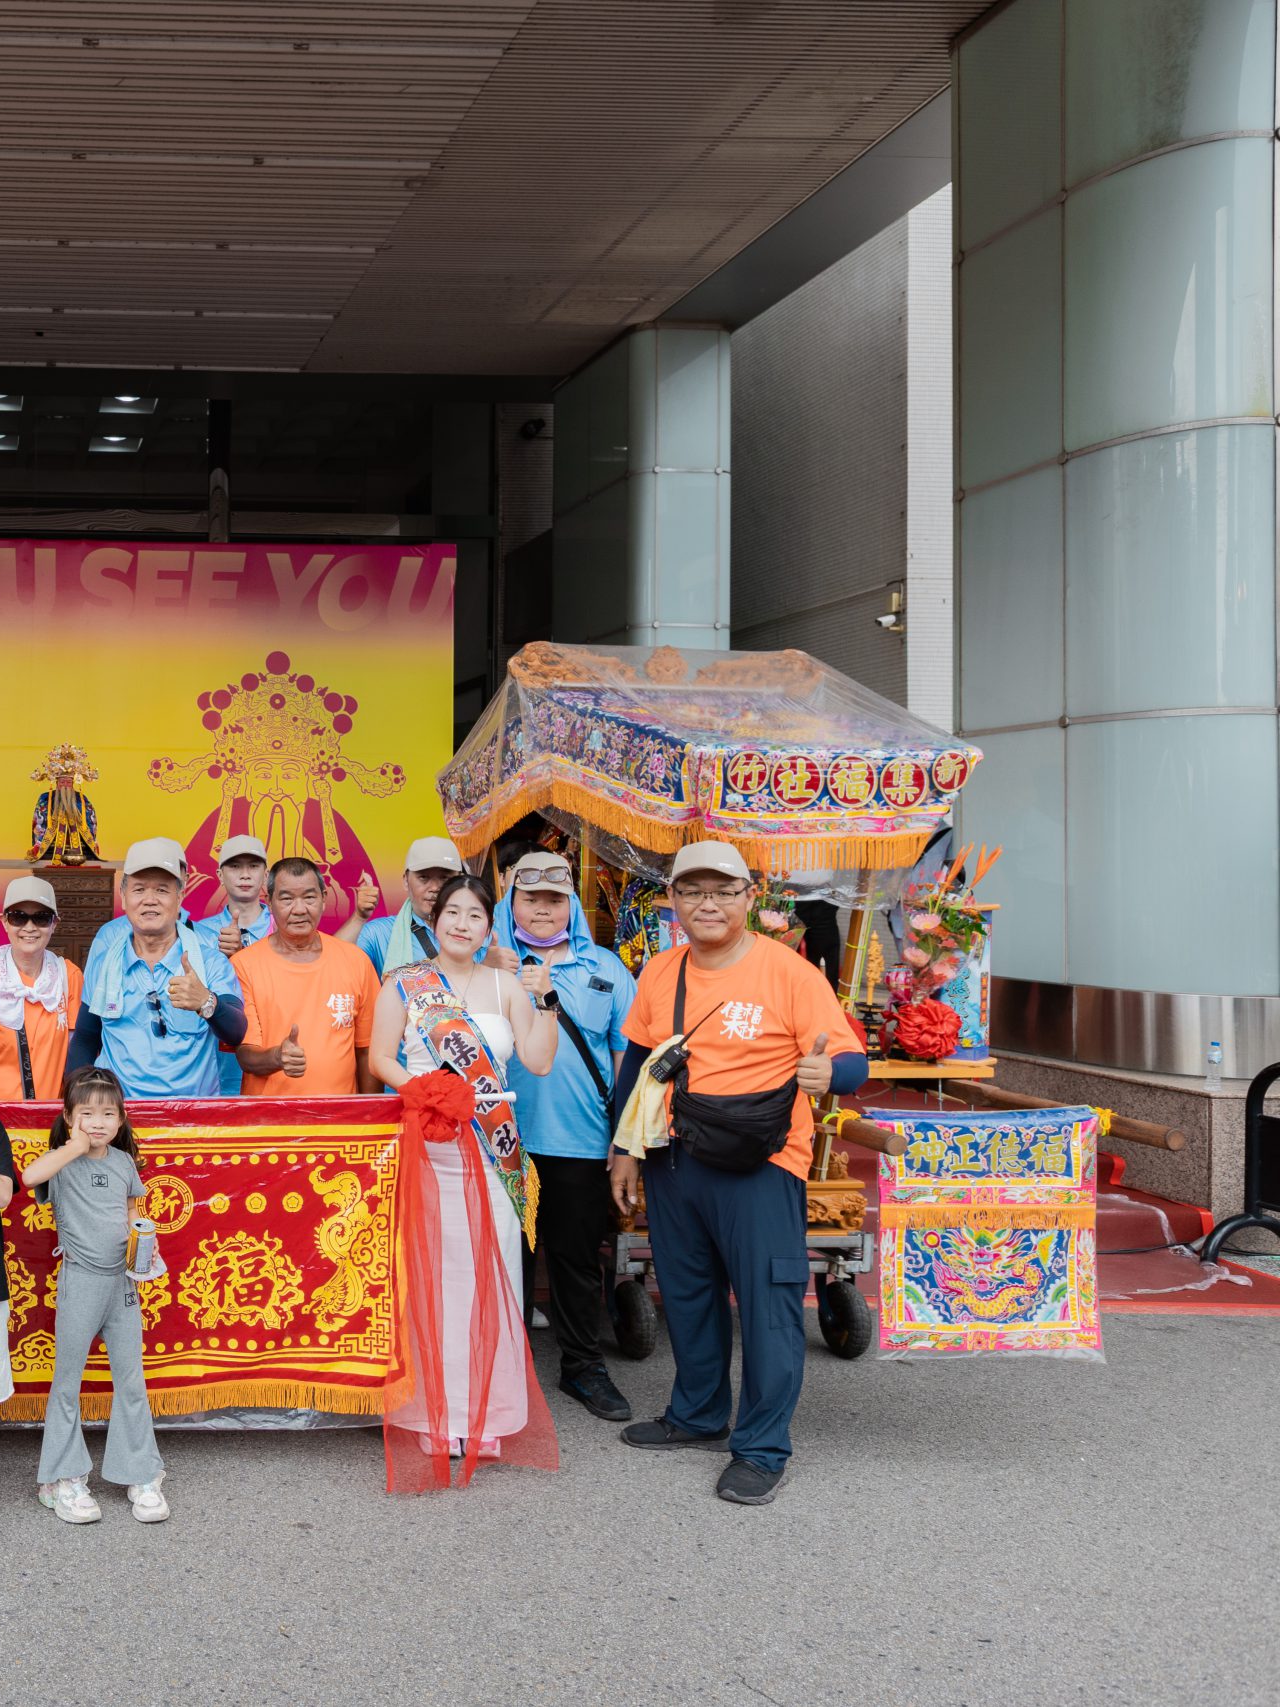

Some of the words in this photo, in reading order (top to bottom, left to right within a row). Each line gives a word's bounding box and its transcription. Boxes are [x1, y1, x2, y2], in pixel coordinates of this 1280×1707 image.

[79, 547, 246, 622] SEE
[266, 552, 457, 631] YOU
[148, 1188, 180, 1220] 新
